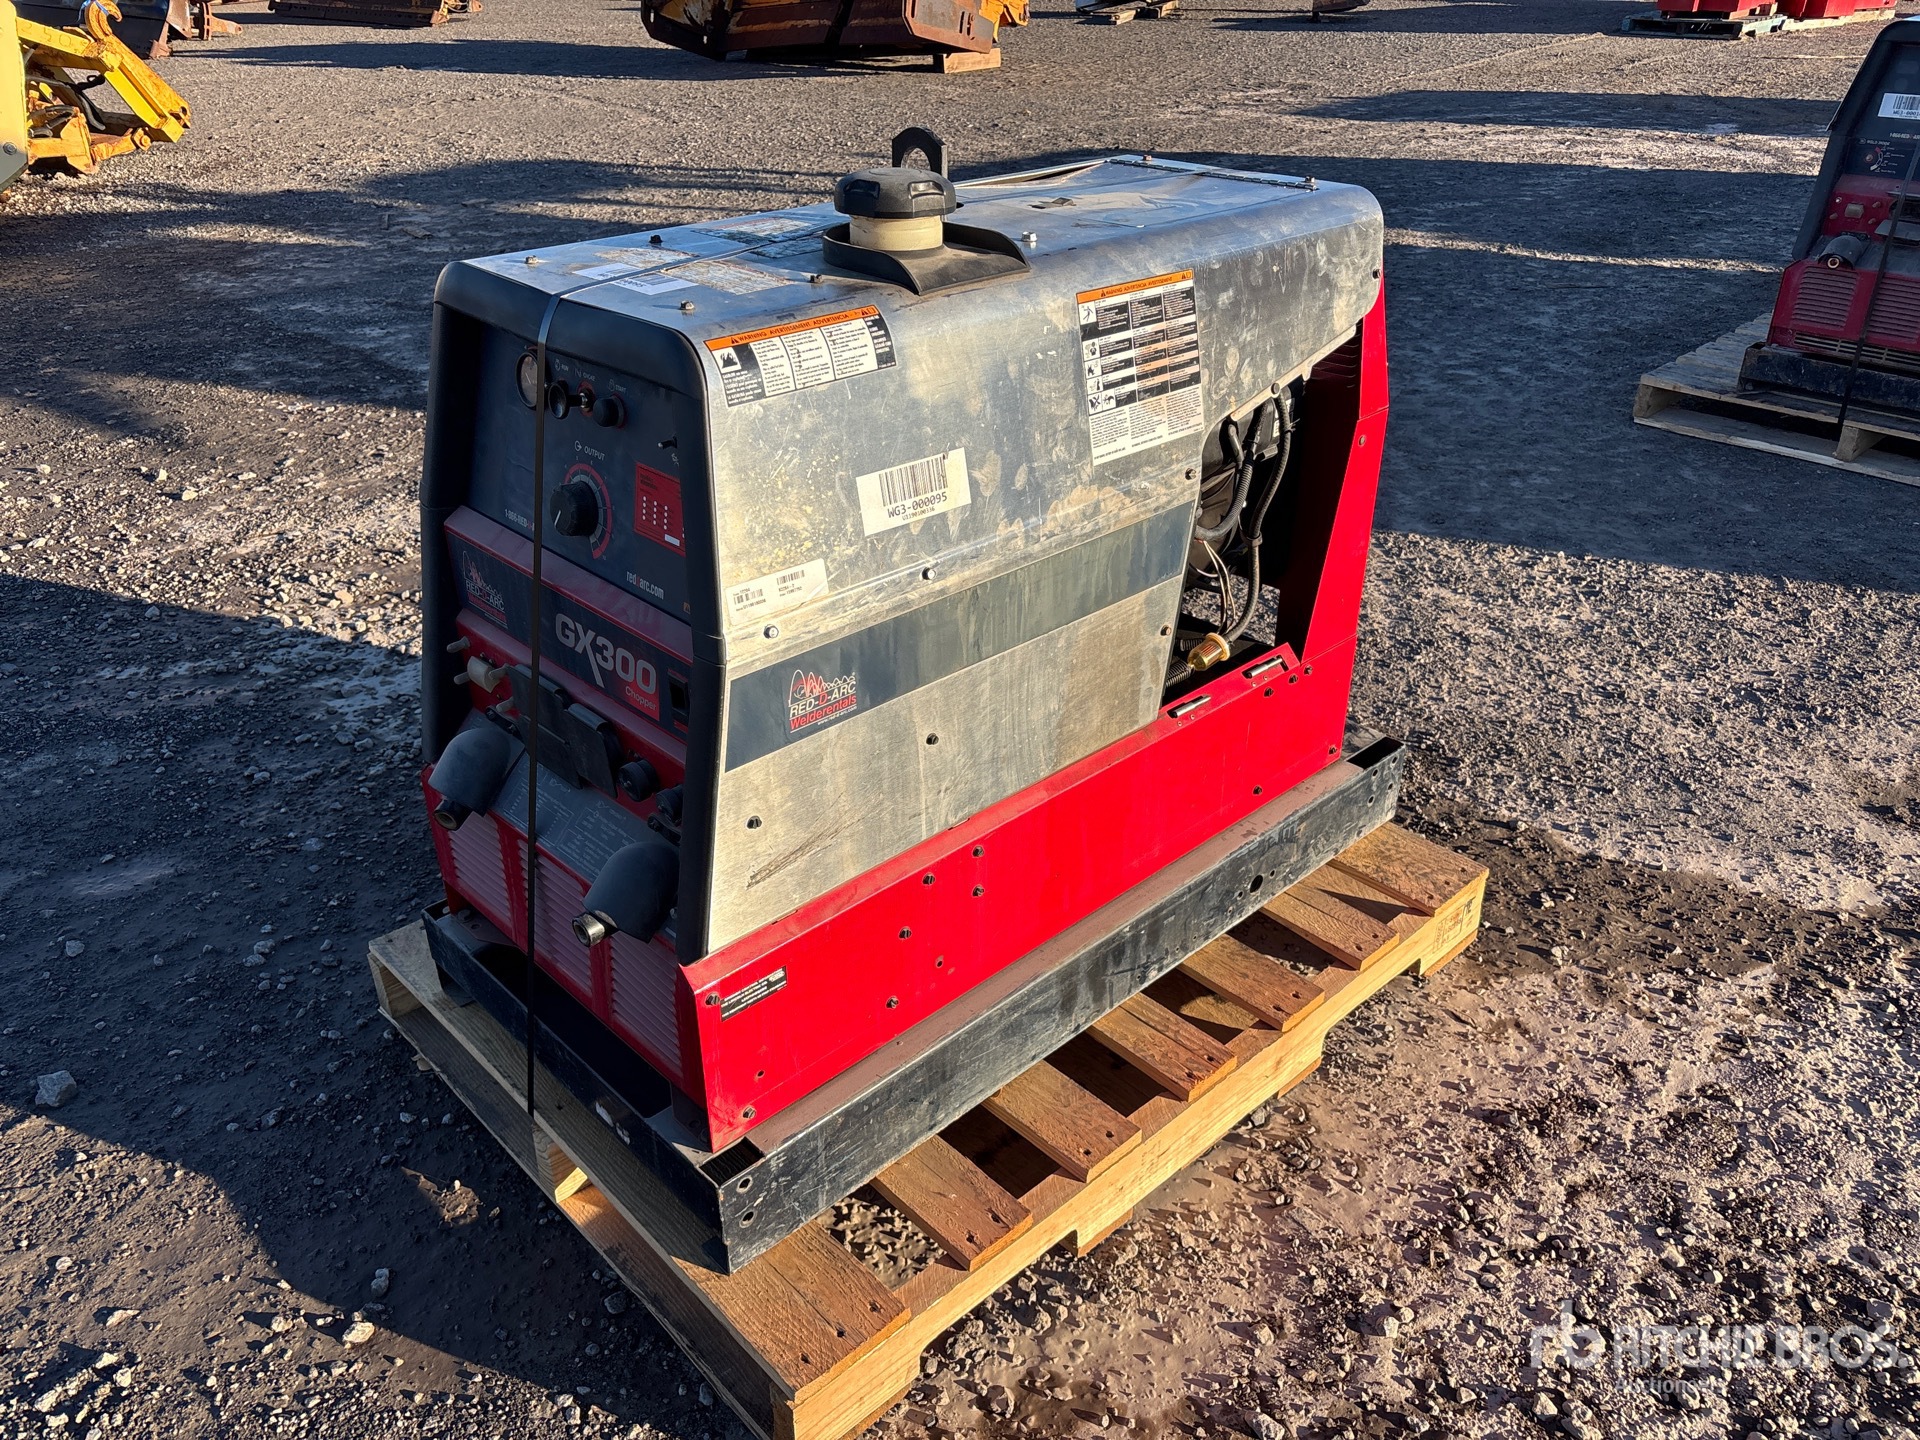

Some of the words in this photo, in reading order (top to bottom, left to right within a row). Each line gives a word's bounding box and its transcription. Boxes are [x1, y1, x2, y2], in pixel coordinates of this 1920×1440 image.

[738, 331, 767, 343] WARNING
[584, 445, 605, 461] OUTPUT
[887, 491, 947, 518] WG3-000095
[555, 613, 656, 695] GX300
[625, 686, 657, 711] Chopper
[789, 681, 856, 718] RED-D-ARC
[790, 694, 857, 730] Welderentals
